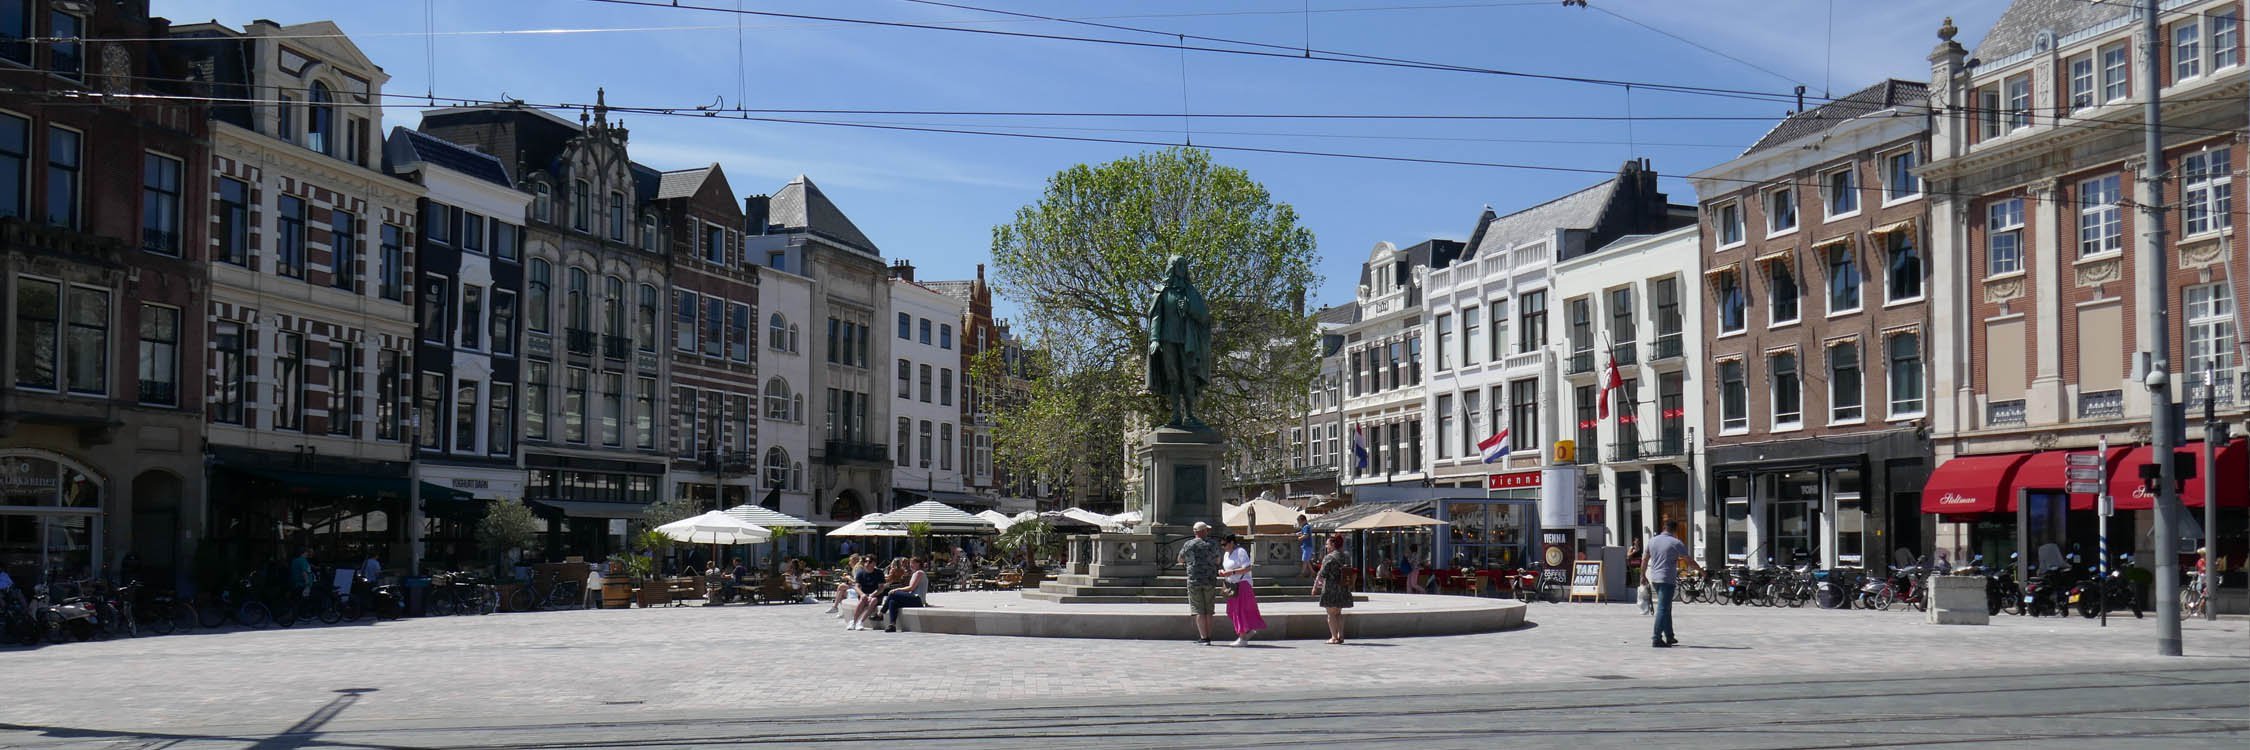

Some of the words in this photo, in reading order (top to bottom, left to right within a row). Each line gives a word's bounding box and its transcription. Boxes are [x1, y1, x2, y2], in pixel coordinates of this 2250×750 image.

[452, 479, 474, 489] YOGHURT
[475, 479, 489, 489] BARN
[1491, 475, 1540, 487] vienna
[1543, 533, 1566, 544] VIENNA
[1576, 564, 1599, 575] TAKE
[1573, 575, 1597, 584] AWAY
